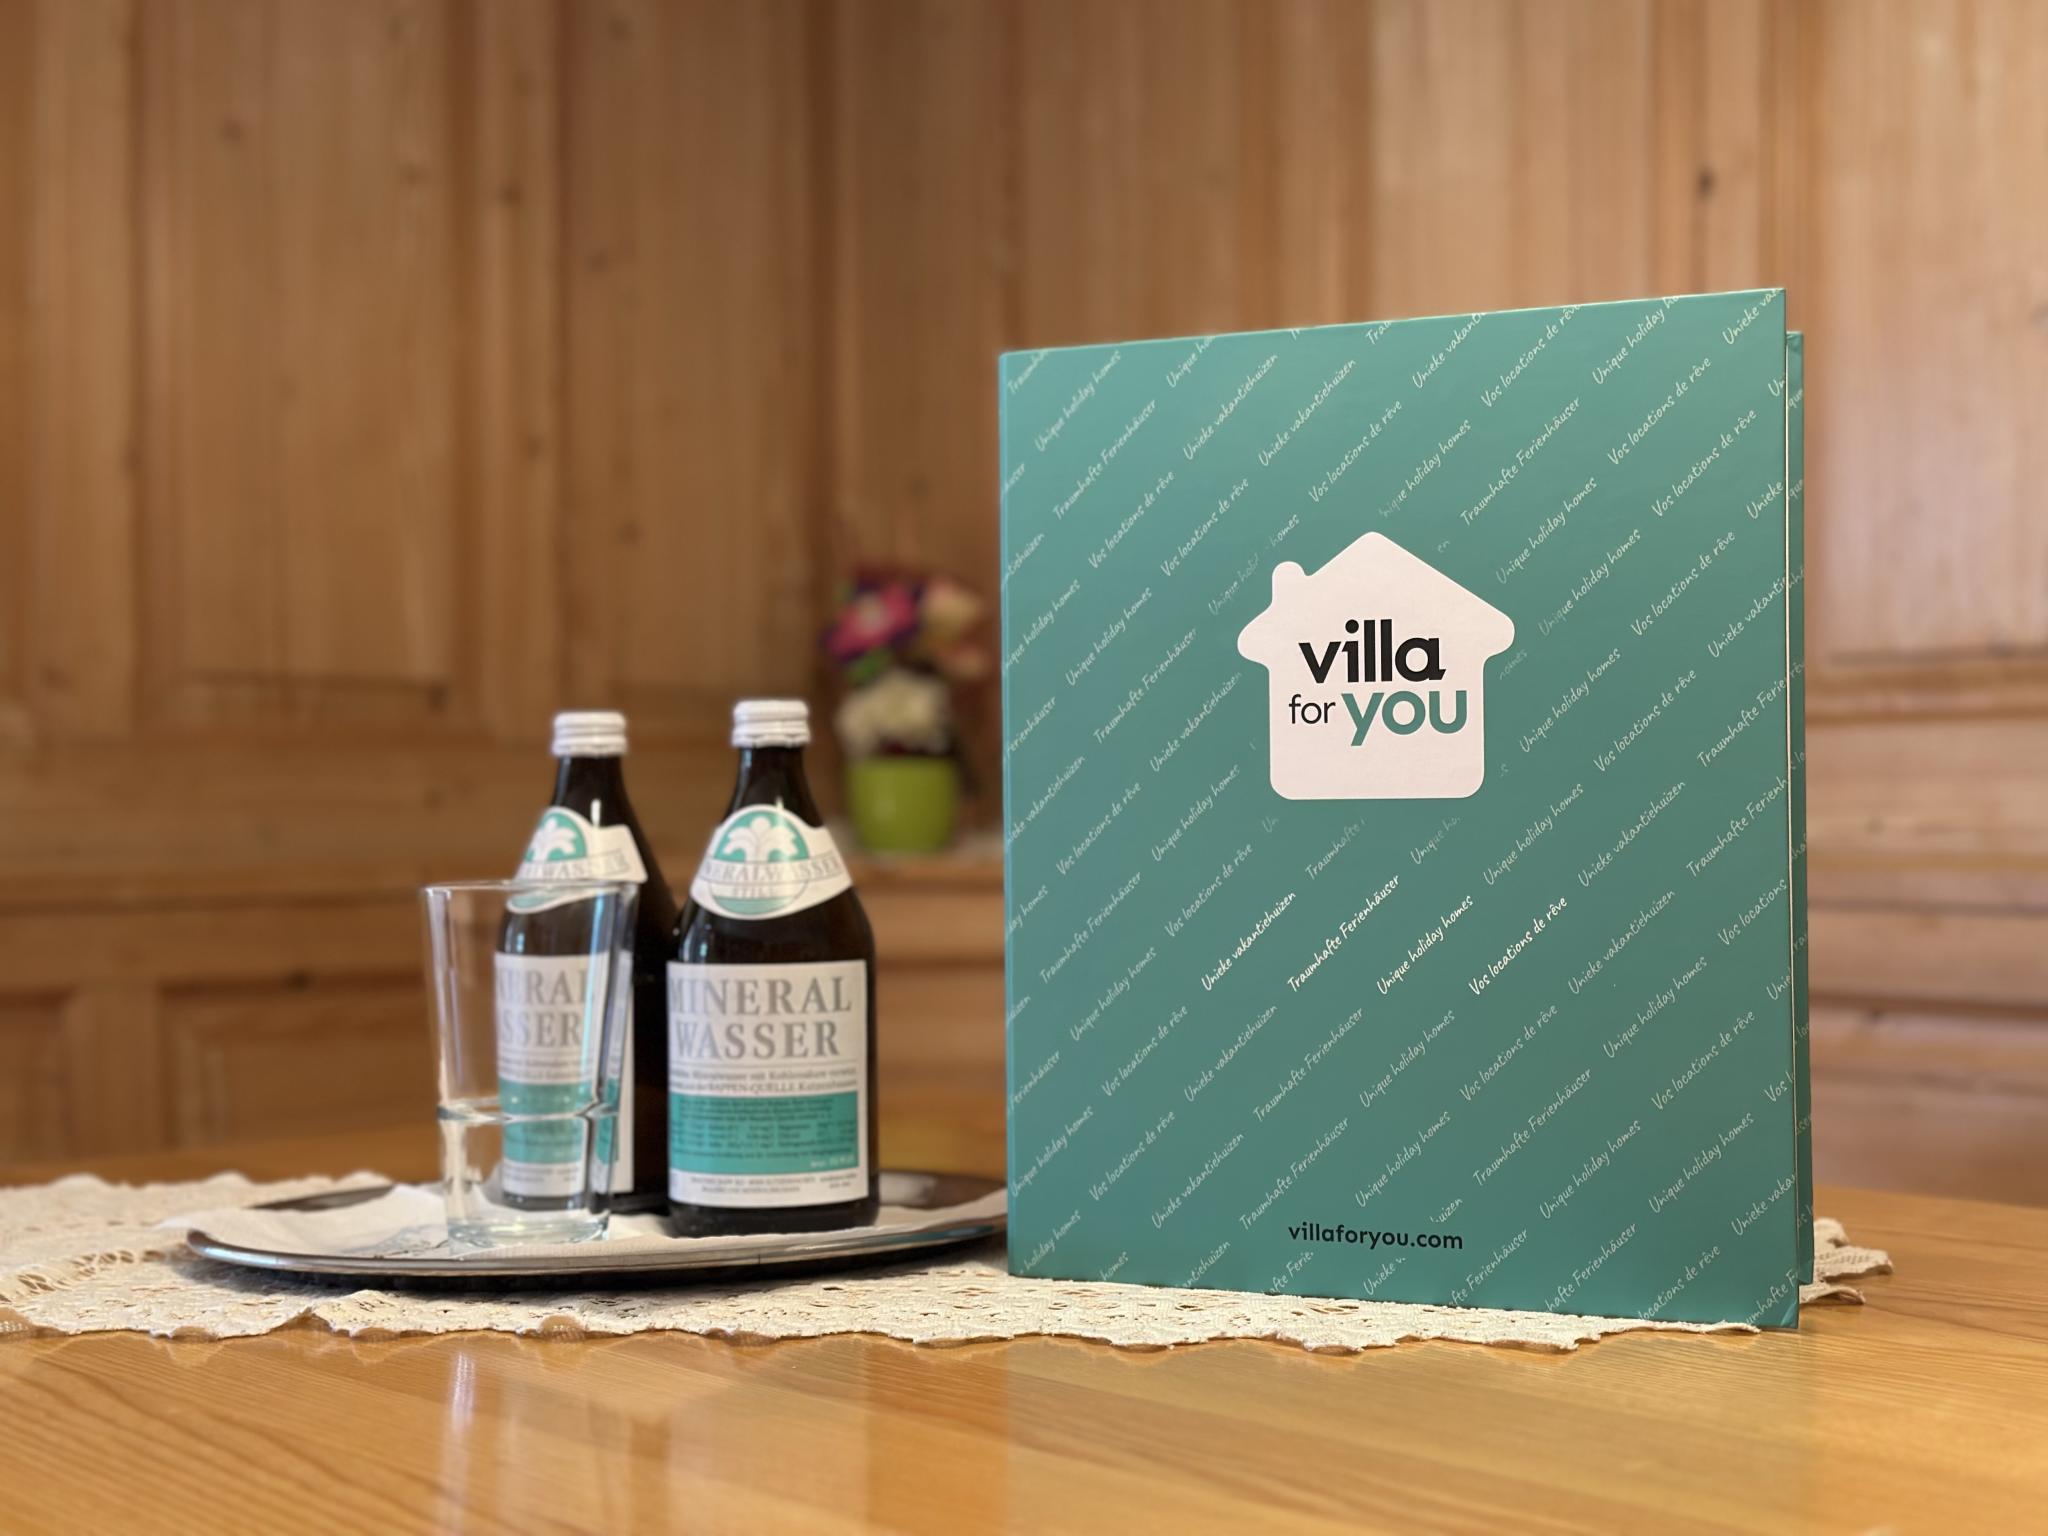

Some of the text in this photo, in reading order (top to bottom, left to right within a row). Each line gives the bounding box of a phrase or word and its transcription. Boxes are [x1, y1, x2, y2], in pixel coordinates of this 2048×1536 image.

[1165, 352, 1198, 388] Unique
[1411, 352, 1446, 389] Unieke
[1480, 384, 1503, 408] Vos
[1499, 338, 1546, 389] locations
[1545, 324, 1559, 341] de
[1591, 308, 1665, 385] Unique holiday
[1721, 306, 1760, 345] Unieke
[1182, 354, 1278, 461] Unieke vakantiehuizen
[1257, 359, 1357, 467] Unieke vakantiehuizen
[1308, 400, 1403, 503] Vos locations de rêve
[1404, 453, 1442, 492] holiday
[1438, 419, 1472, 455] homes
[1607, 357, 1711, 465] Vos locations de rêve
[1459, 397, 1580, 526] Traumhafte Ferienhäuser
[1650, 409, 1757, 517] Vos locations de rêve
[1747, 481, 1783, 520] Unieke
[1160, 478, 1249, 577] Vos locations de rêve
[1495, 477, 1597, 584] Unique holiday homes
[1571, 562, 1610, 601] holiday
[1606, 528, 1641, 565] homes
[1630, 531, 1736, 636] Vos locations de rêve
[1298, 619, 1446, 684] villa
[1707, 621, 1745, 658] Unieke
[1289, 690, 1467, 746] for you
[1519, 647, 1621, 753] Unique holiday homes
[1592, 669, 1697, 772] Vos locations de rêve
[1696, 706, 1760, 768] Traumhafte
[1151, 764, 1238, 862] Unique holiday homes
[1483, 783, 1584, 886] Unique holiday homes
[1577, 781, 1686, 887] Unieke vakantiehuizen
[1685, 817, 1749, 877] Traumhafte
[1164, 844, 1253, 937] Vos locations de rêve
[1287, 875, 1399, 992] Traumhafte Ferienhäuser
[1717, 879, 1787, 946] Vos locations
[1200, 958, 1233, 991] Unieke
[1231, 892, 1297, 959] vakantiehuizen
[1376, 895, 1474, 995] Unique holiday homes
[1468, 897, 1568, 996] Vos locations de rêve
[1567, 890, 1676, 995] Unieke vakantiehuizen
[669, 975, 851, 1016] MINERAL
[674, 1019, 839, 1060] WASSER
[1602, 956, 1708, 1058] Unique holiday homes
[1183, 1005, 1278, 1102] Unieke vakantiehuizen
[1252, 1007, 1363, 1122] Traumhafte Ferienhäuser
[1359, 1009, 1456, 1108] Unique holiday homes
[1459, 1005, 1558, 1101] Vos locations de rêve
[1650, 1011, 1755, 1111] Vos locations de rêve
[1764, 1080, 1788, 1103] Vos
[1239, 1175, 1293, 1230] Traumhafte
[1289, 1117, 1348, 1180] Ferienhäuser
[1355, 1111, 1451, 1208] Unique holiday homes
[1472, 1068, 1591, 1186] Traumhafte Ferienhäuser
[1539, 1120, 1641, 1219] Unique holiday homes
[1648, 1177, 1685, 1214] Unique
[1682, 1144, 1722, 1181] holiday
[1718, 1112, 1755, 1147] homes
[1151, 1133, 1244, 1229] Unieke vakantiehuizen
[1730, 1200, 1768, 1236] Unieke
[1288, 1222, 1463, 1250] villaforyou.com
[1364, 1262, 1396, 1296] Unieke
[1465, 1228, 1527, 1292] Ferienhäuser
[1571, 1223, 1636, 1288] Ferienhäuser
[1684, 1265, 1698, 1282] de
[1698, 1246, 1721, 1269] rêve
